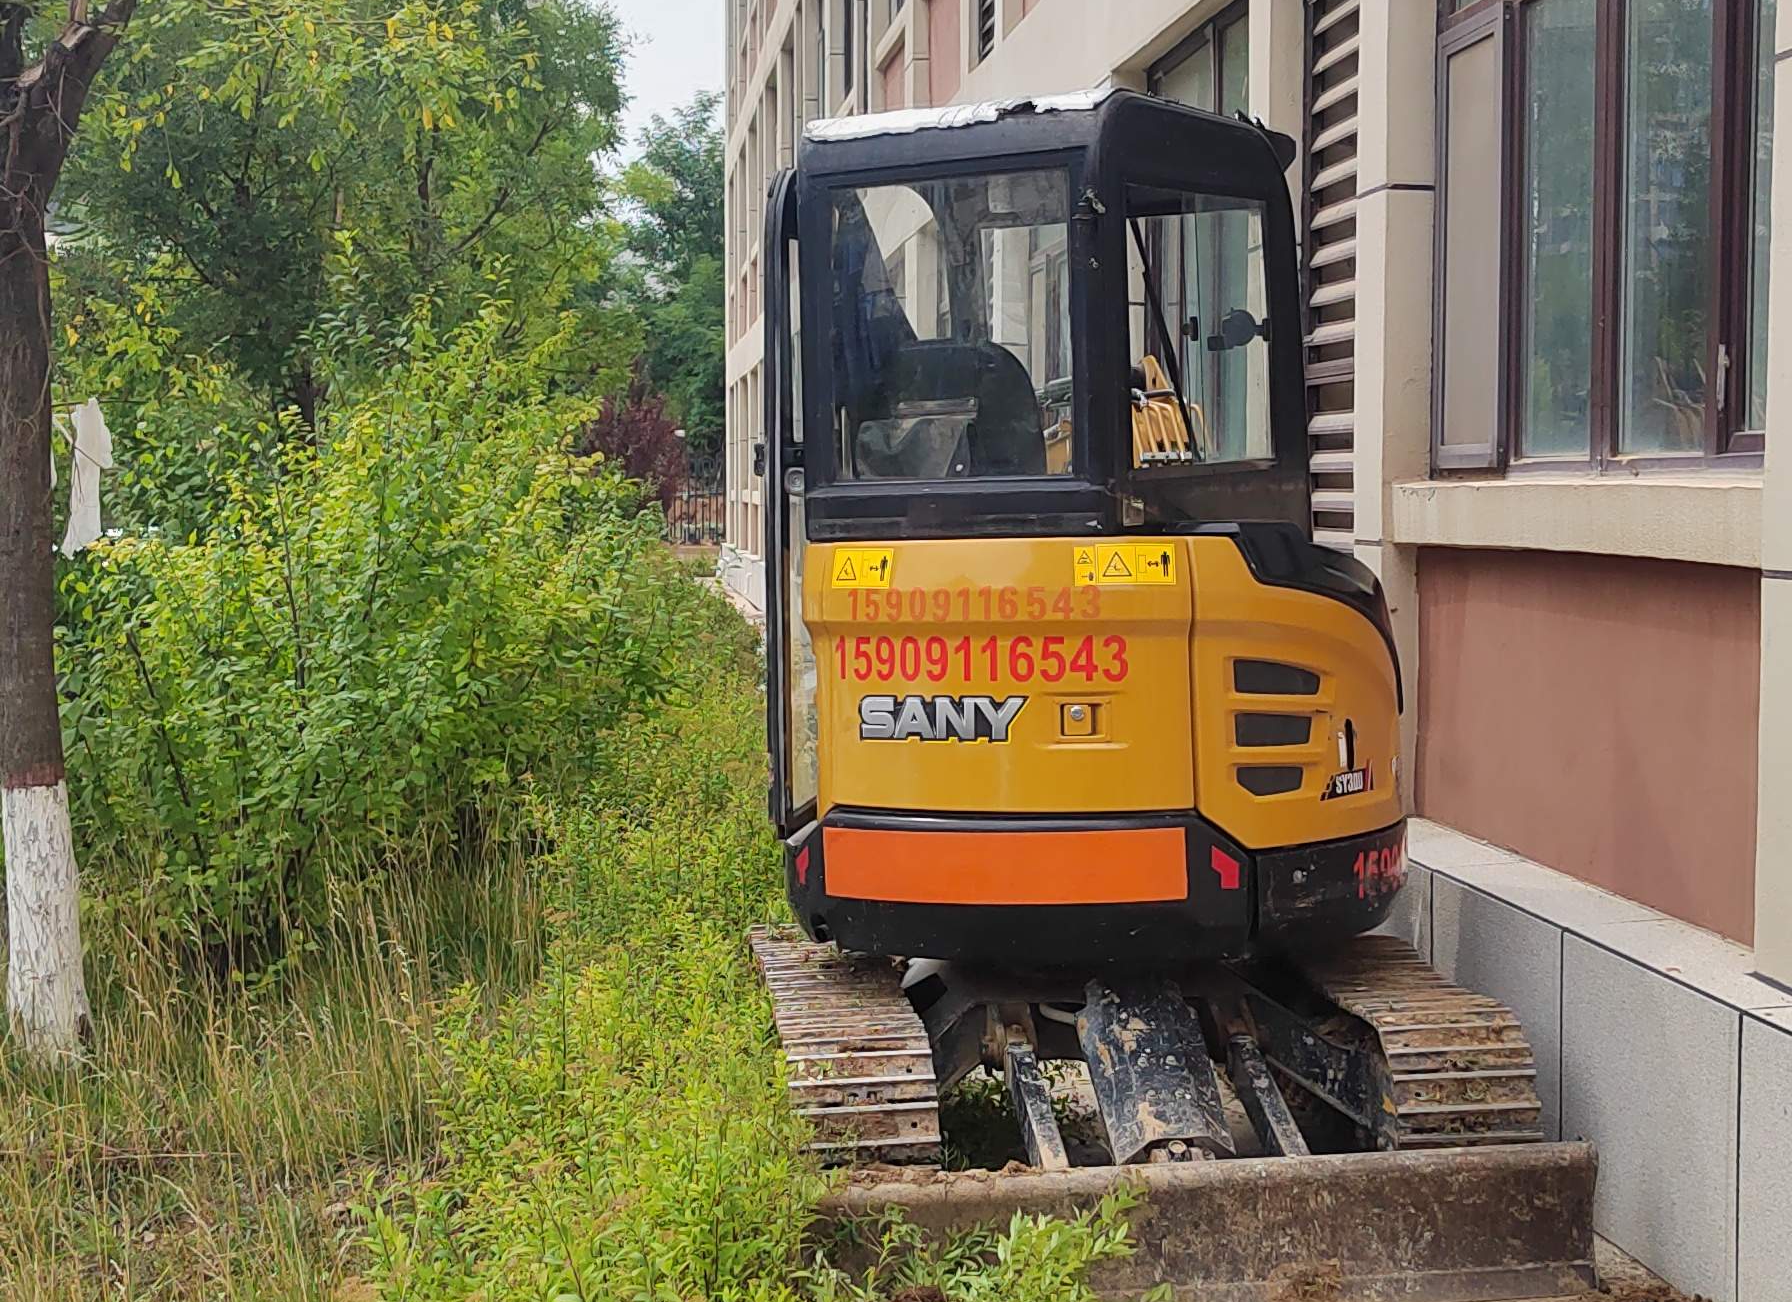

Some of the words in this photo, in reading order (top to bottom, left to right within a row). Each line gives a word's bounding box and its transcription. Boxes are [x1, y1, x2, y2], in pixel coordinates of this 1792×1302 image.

[847, 584, 1101, 622] 15909116543
[834, 634, 1129, 683] 15909116543
[860, 695, 1027, 741] SANY
